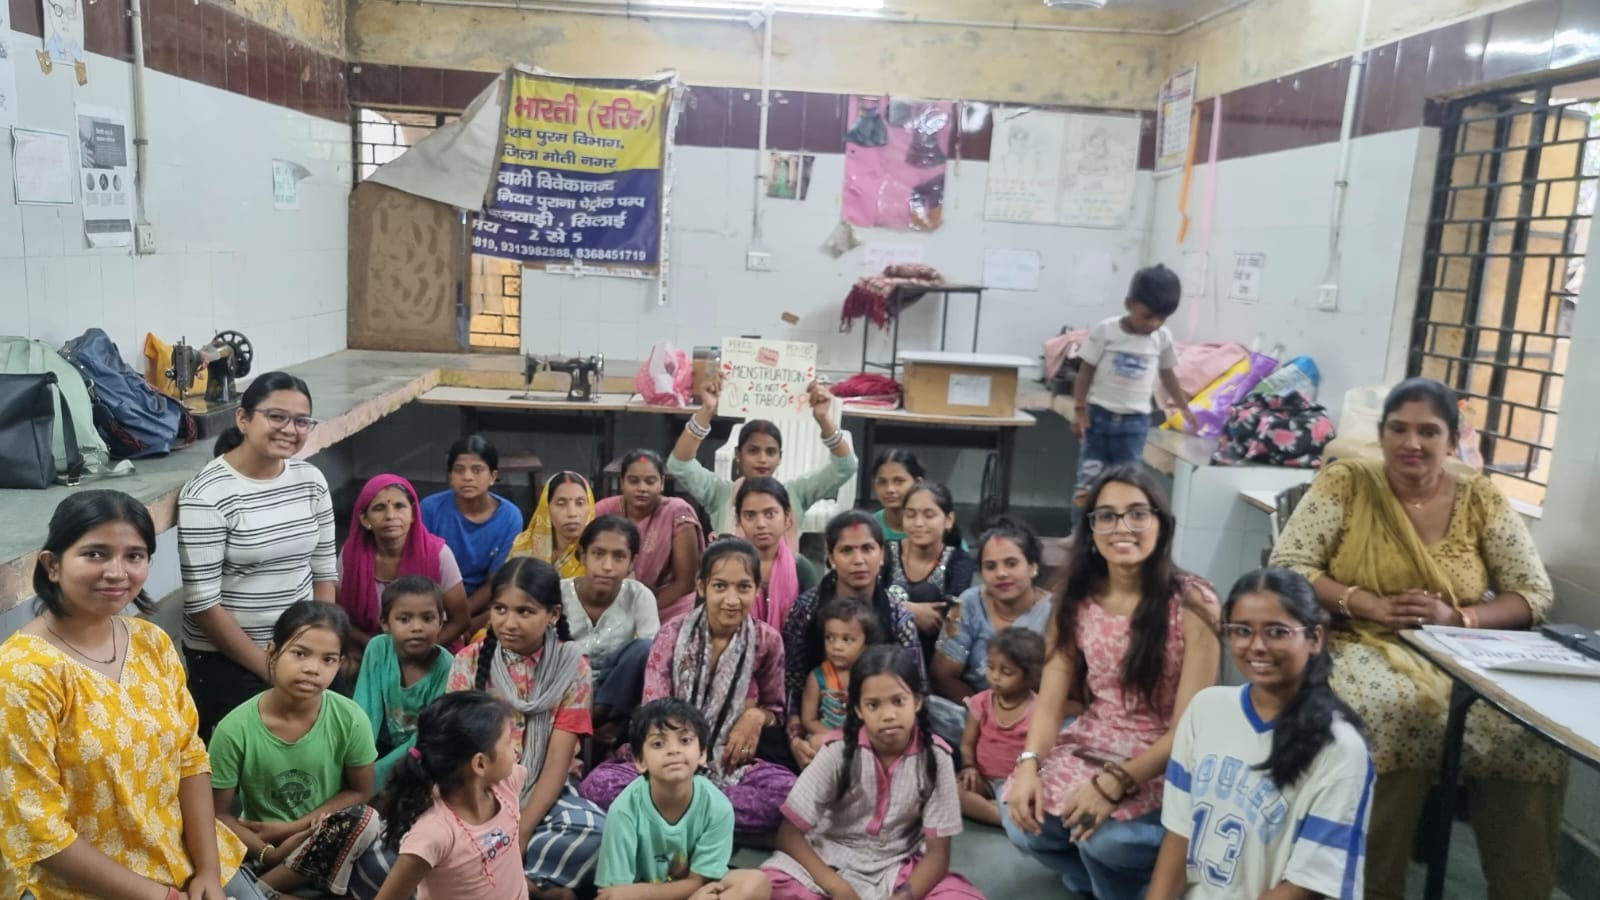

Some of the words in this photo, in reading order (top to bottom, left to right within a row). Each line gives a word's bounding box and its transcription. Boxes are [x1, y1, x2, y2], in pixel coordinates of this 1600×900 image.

[514, 93, 577, 125] भारती
[537, 130, 568, 147] पुरम
[543, 149, 577, 165] मोती
[581, 156, 616, 169] नगर
[497, 188, 534, 206] नियर
[537, 196, 576, 212] पुराना
[617, 196, 645, 208] पम्प
[571, 211, 627, 229] सिलाई
[529, 229, 540, 241] 2
[545, 227, 567, 243] से
[572, 232, 583, 243] 5
[764, 383, 780, 393] NOT
[743, 392, 750, 404] A
[754, 392, 787, 408] TABOO
[1186, 798, 1248, 888] 13
